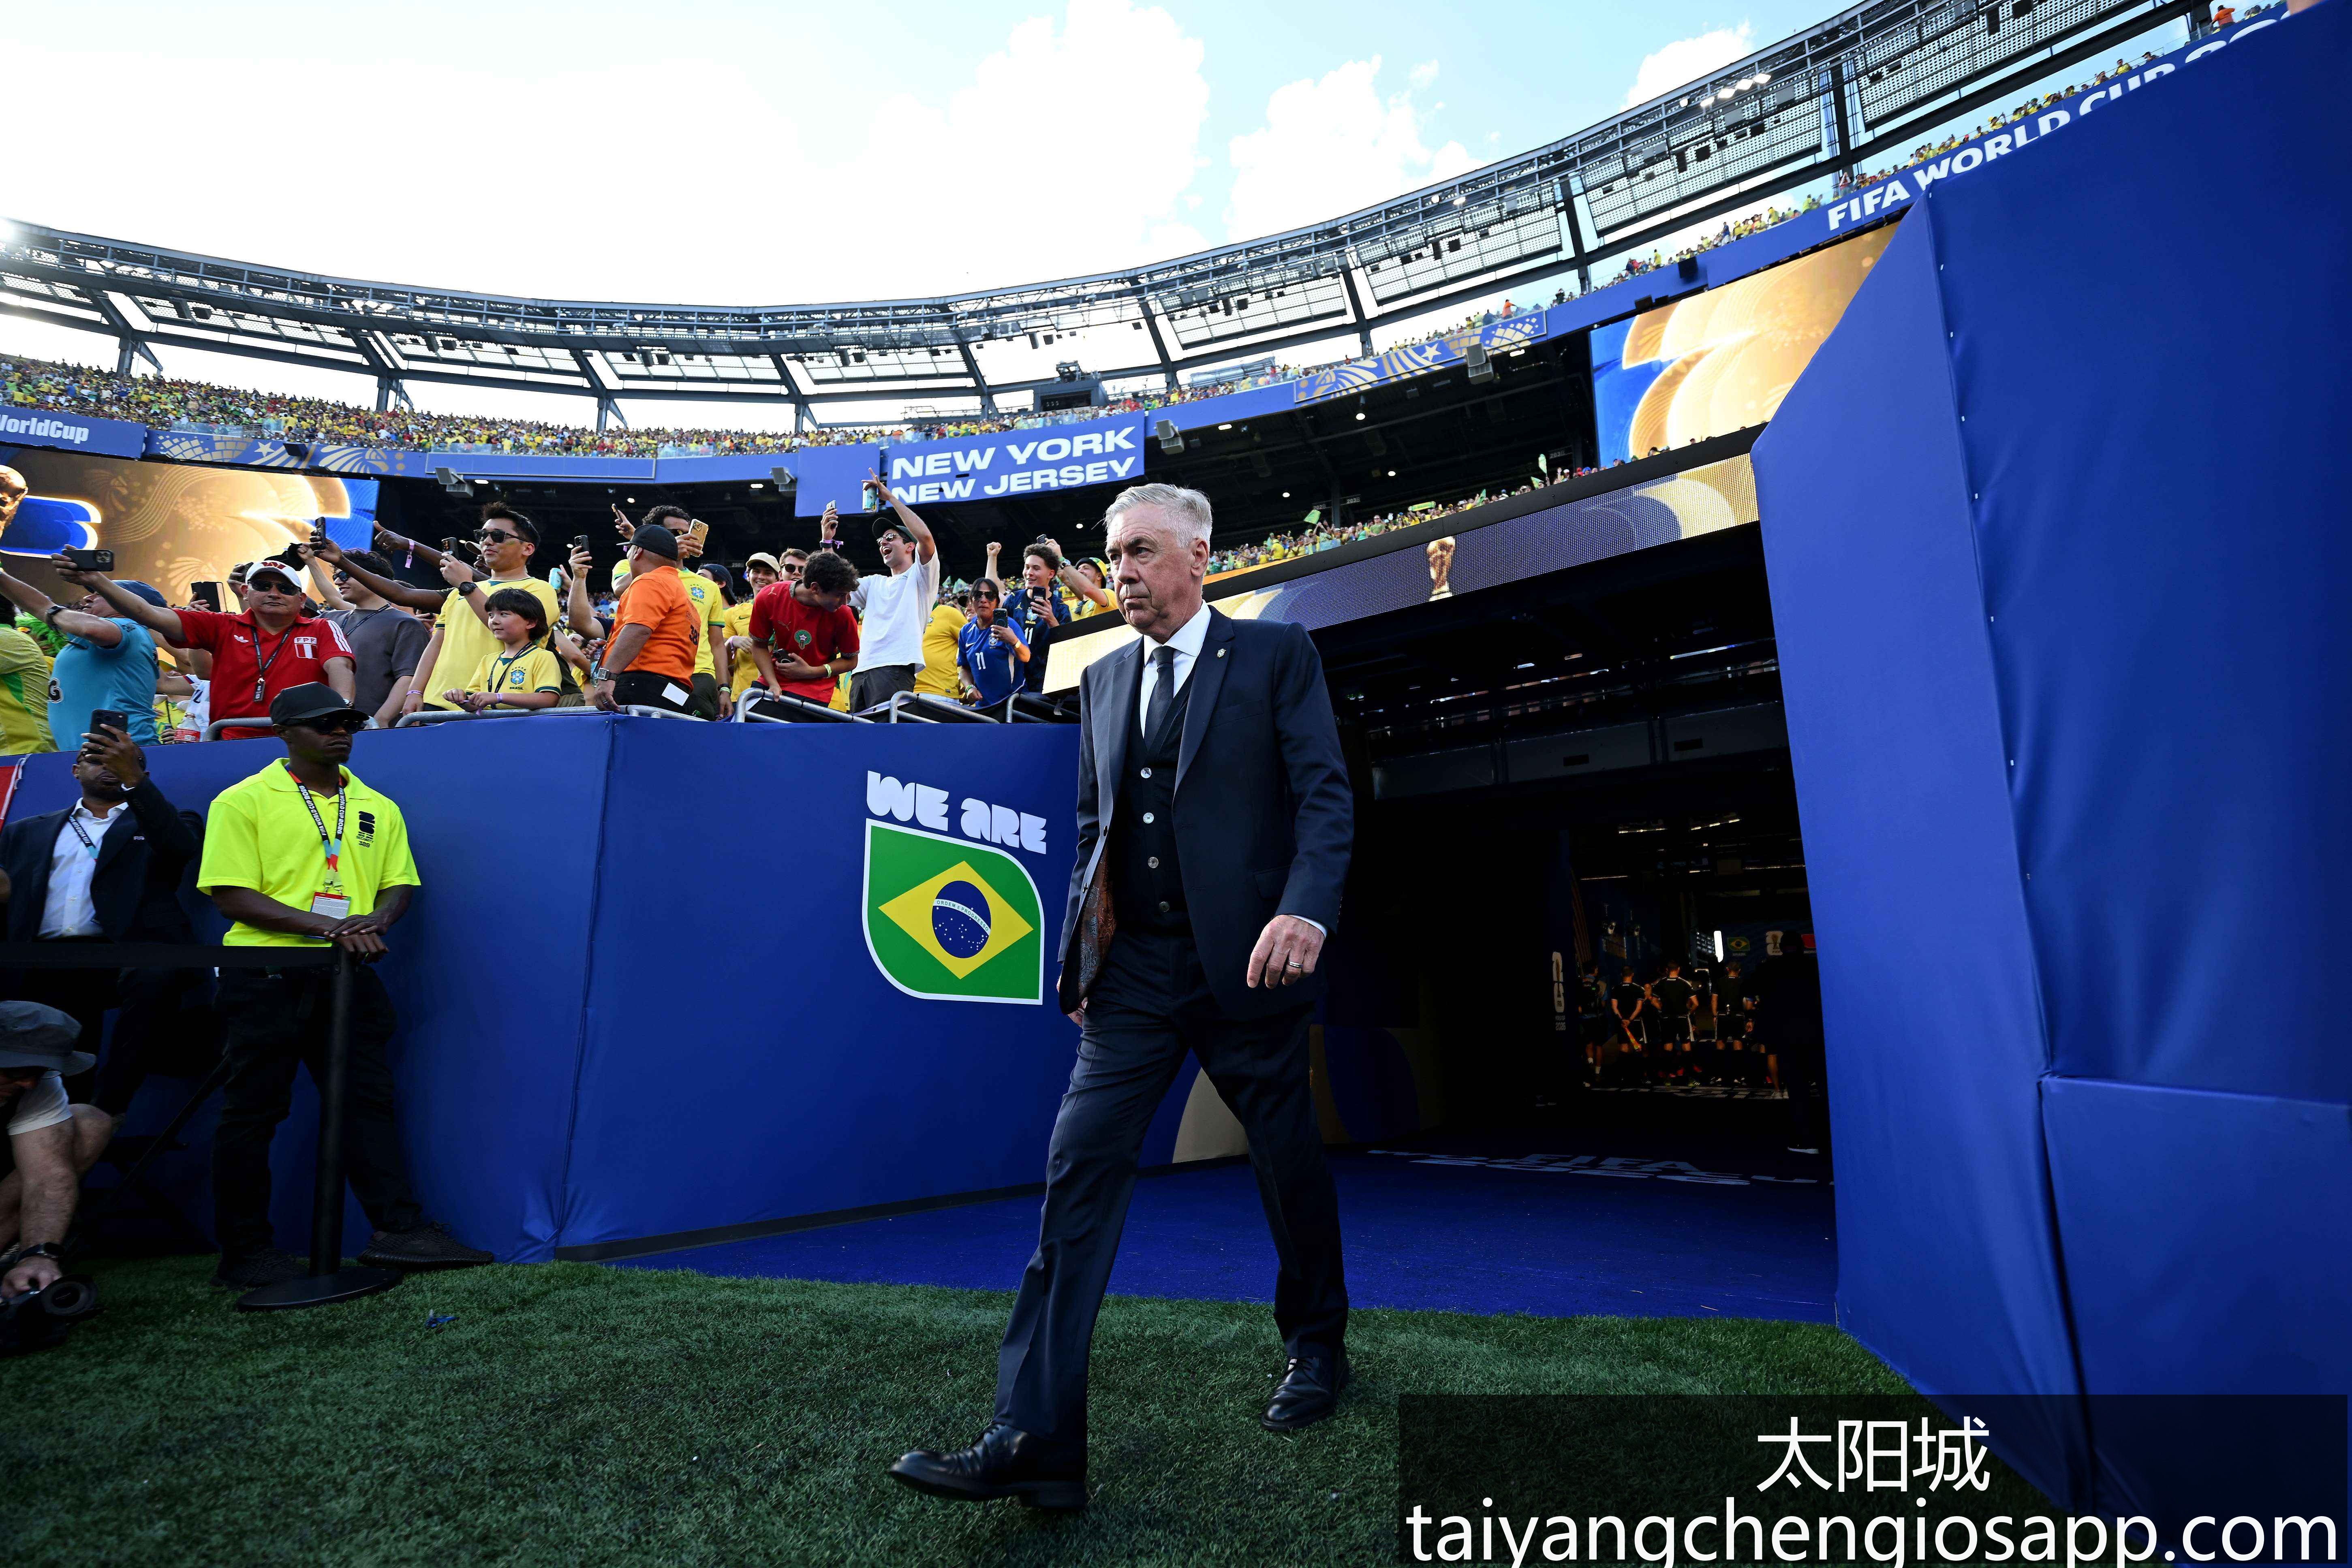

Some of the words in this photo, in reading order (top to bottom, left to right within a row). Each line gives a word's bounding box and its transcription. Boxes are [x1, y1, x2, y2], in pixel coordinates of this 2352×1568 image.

[1828, 180, 1911, 231] FIFA
[1913, 110, 2070, 191] WORLD
[892, 447, 996, 479] NEW
[1007, 426, 1135, 464] YORK
[892, 479, 974, 504] NEW
[984, 457, 1135, 494] JERSEY
[975, 652, 986, 670] 11
[866, 770, 949, 831] WE
[961, 797, 1046, 854] ARE
[961, 907, 988, 931] PROGRESSO
[1518, 1154, 1700, 1171] FIFA
